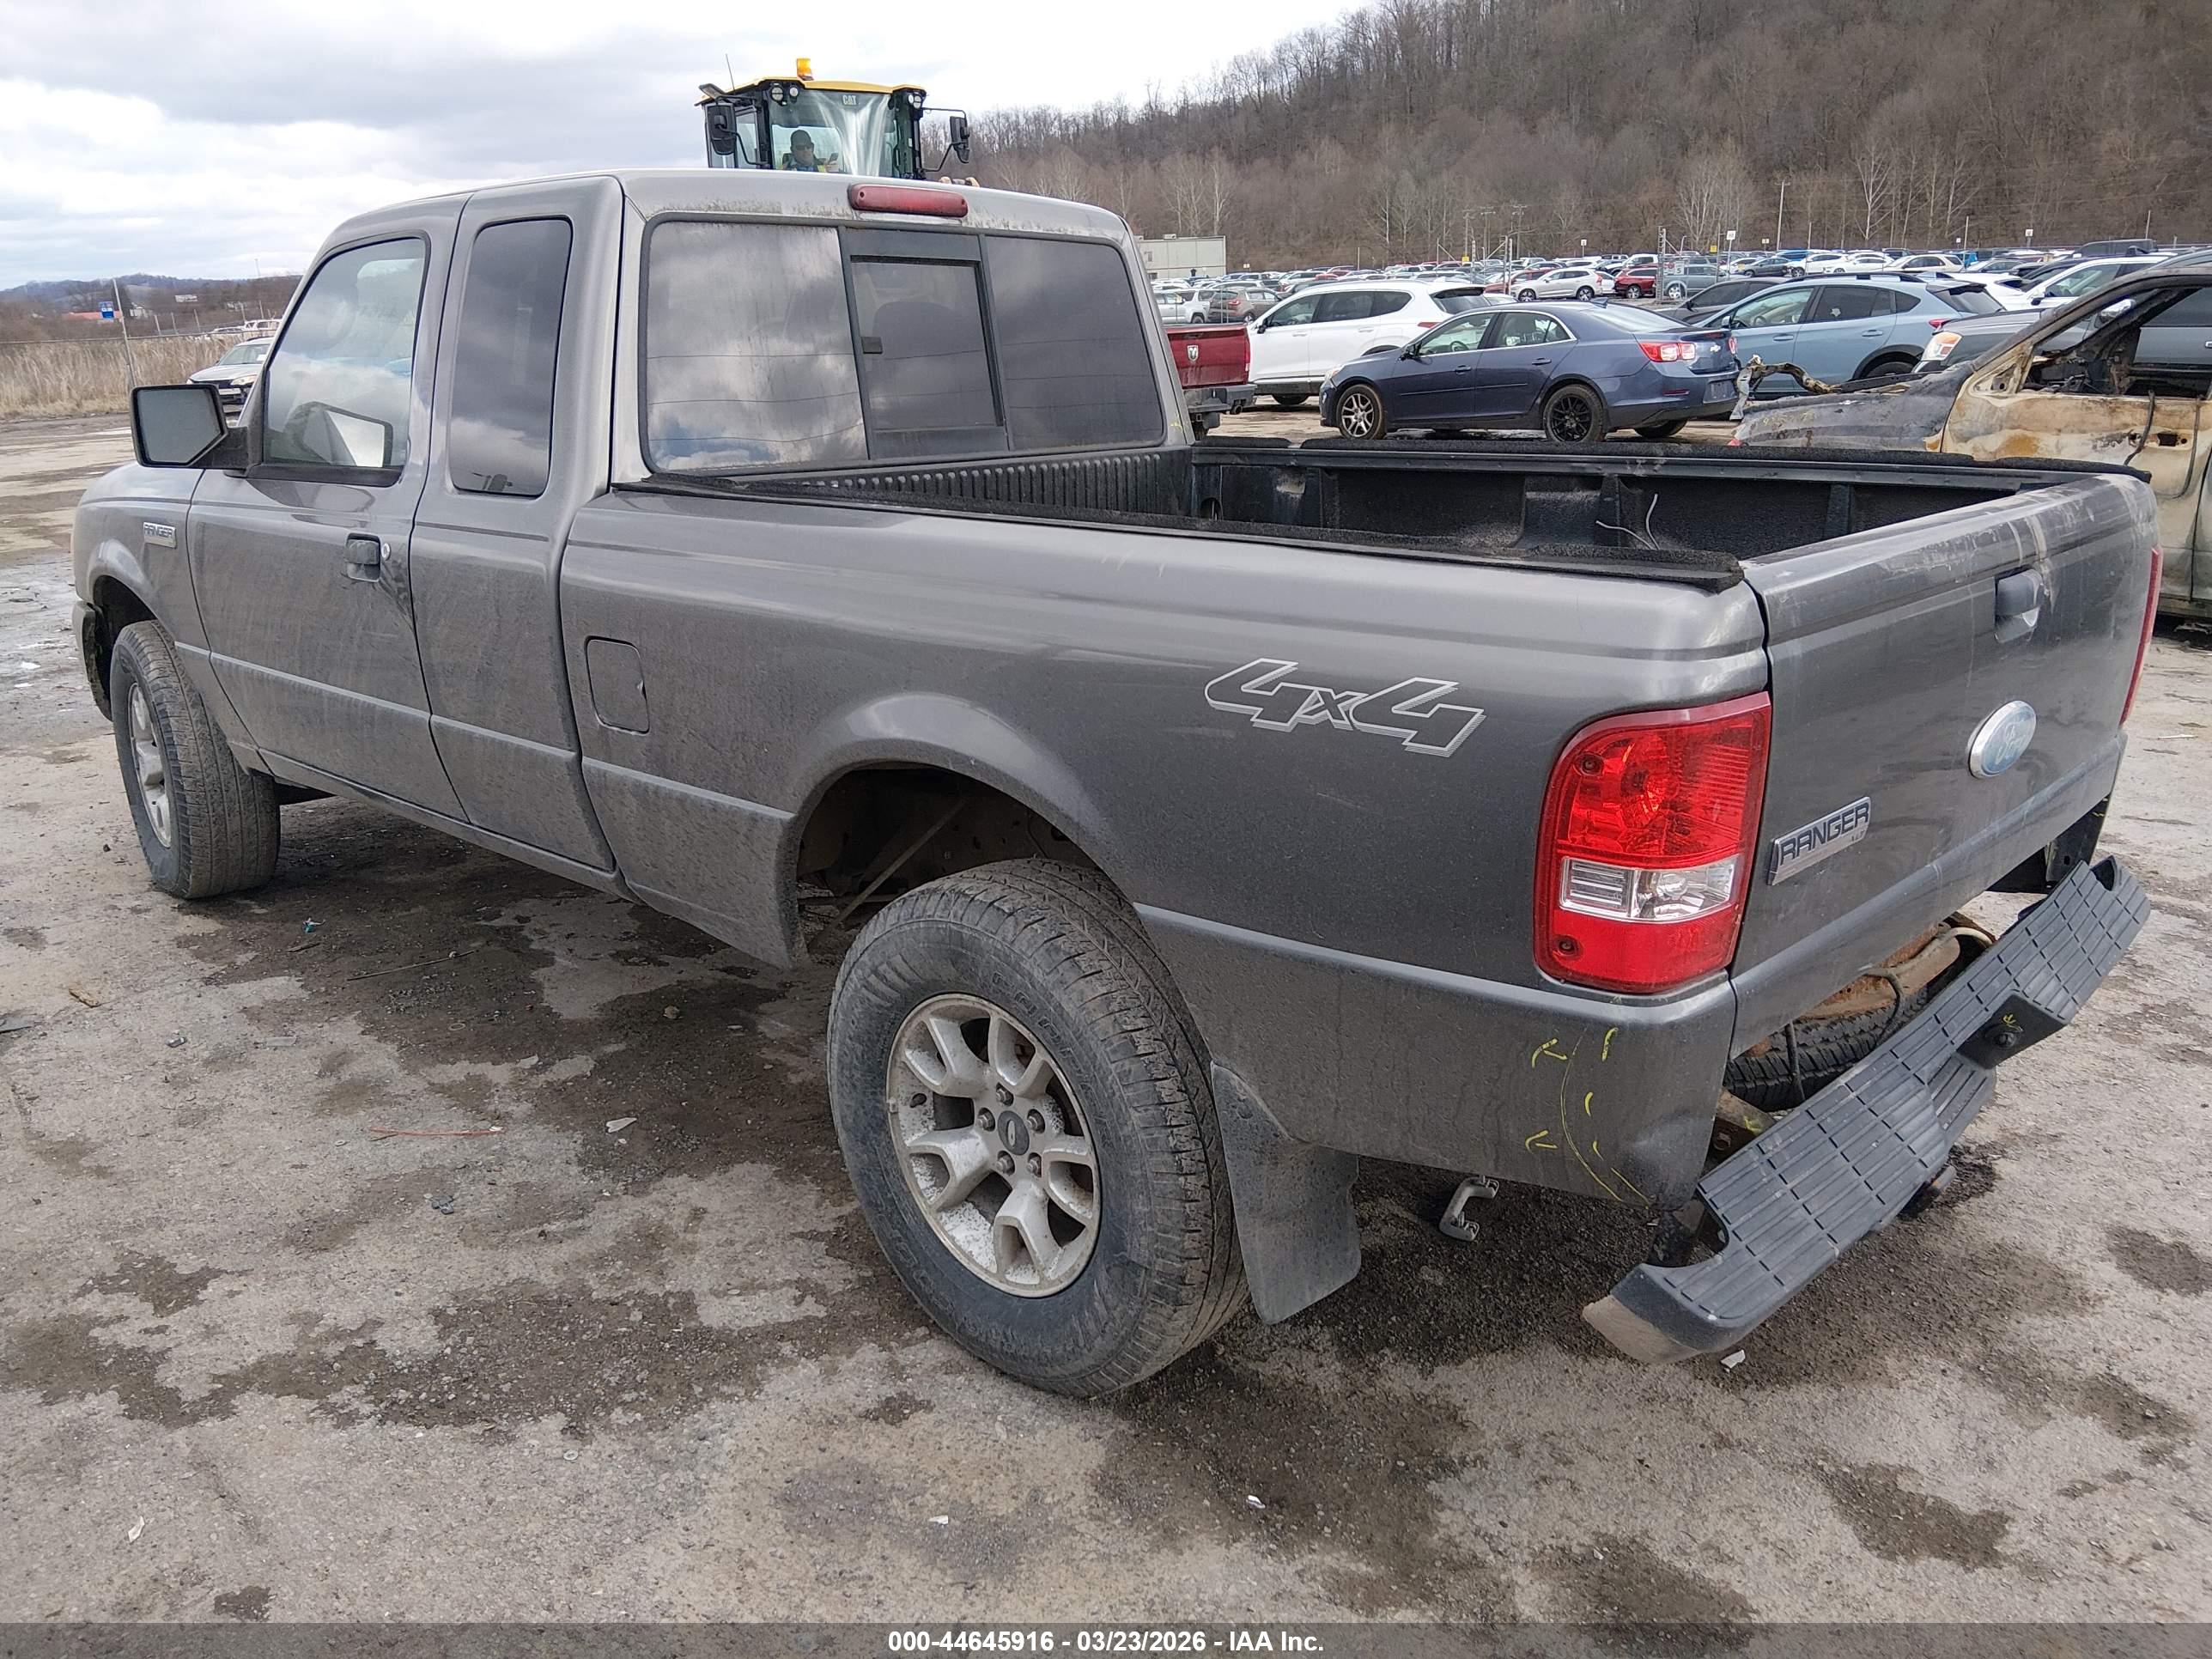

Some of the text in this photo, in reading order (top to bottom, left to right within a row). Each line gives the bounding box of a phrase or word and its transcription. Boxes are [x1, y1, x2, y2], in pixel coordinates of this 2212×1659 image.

[842, 94, 857, 106] CAT
[1204, 658, 1487, 757] 4x4
[1780, 802, 1869, 866] RANGER
